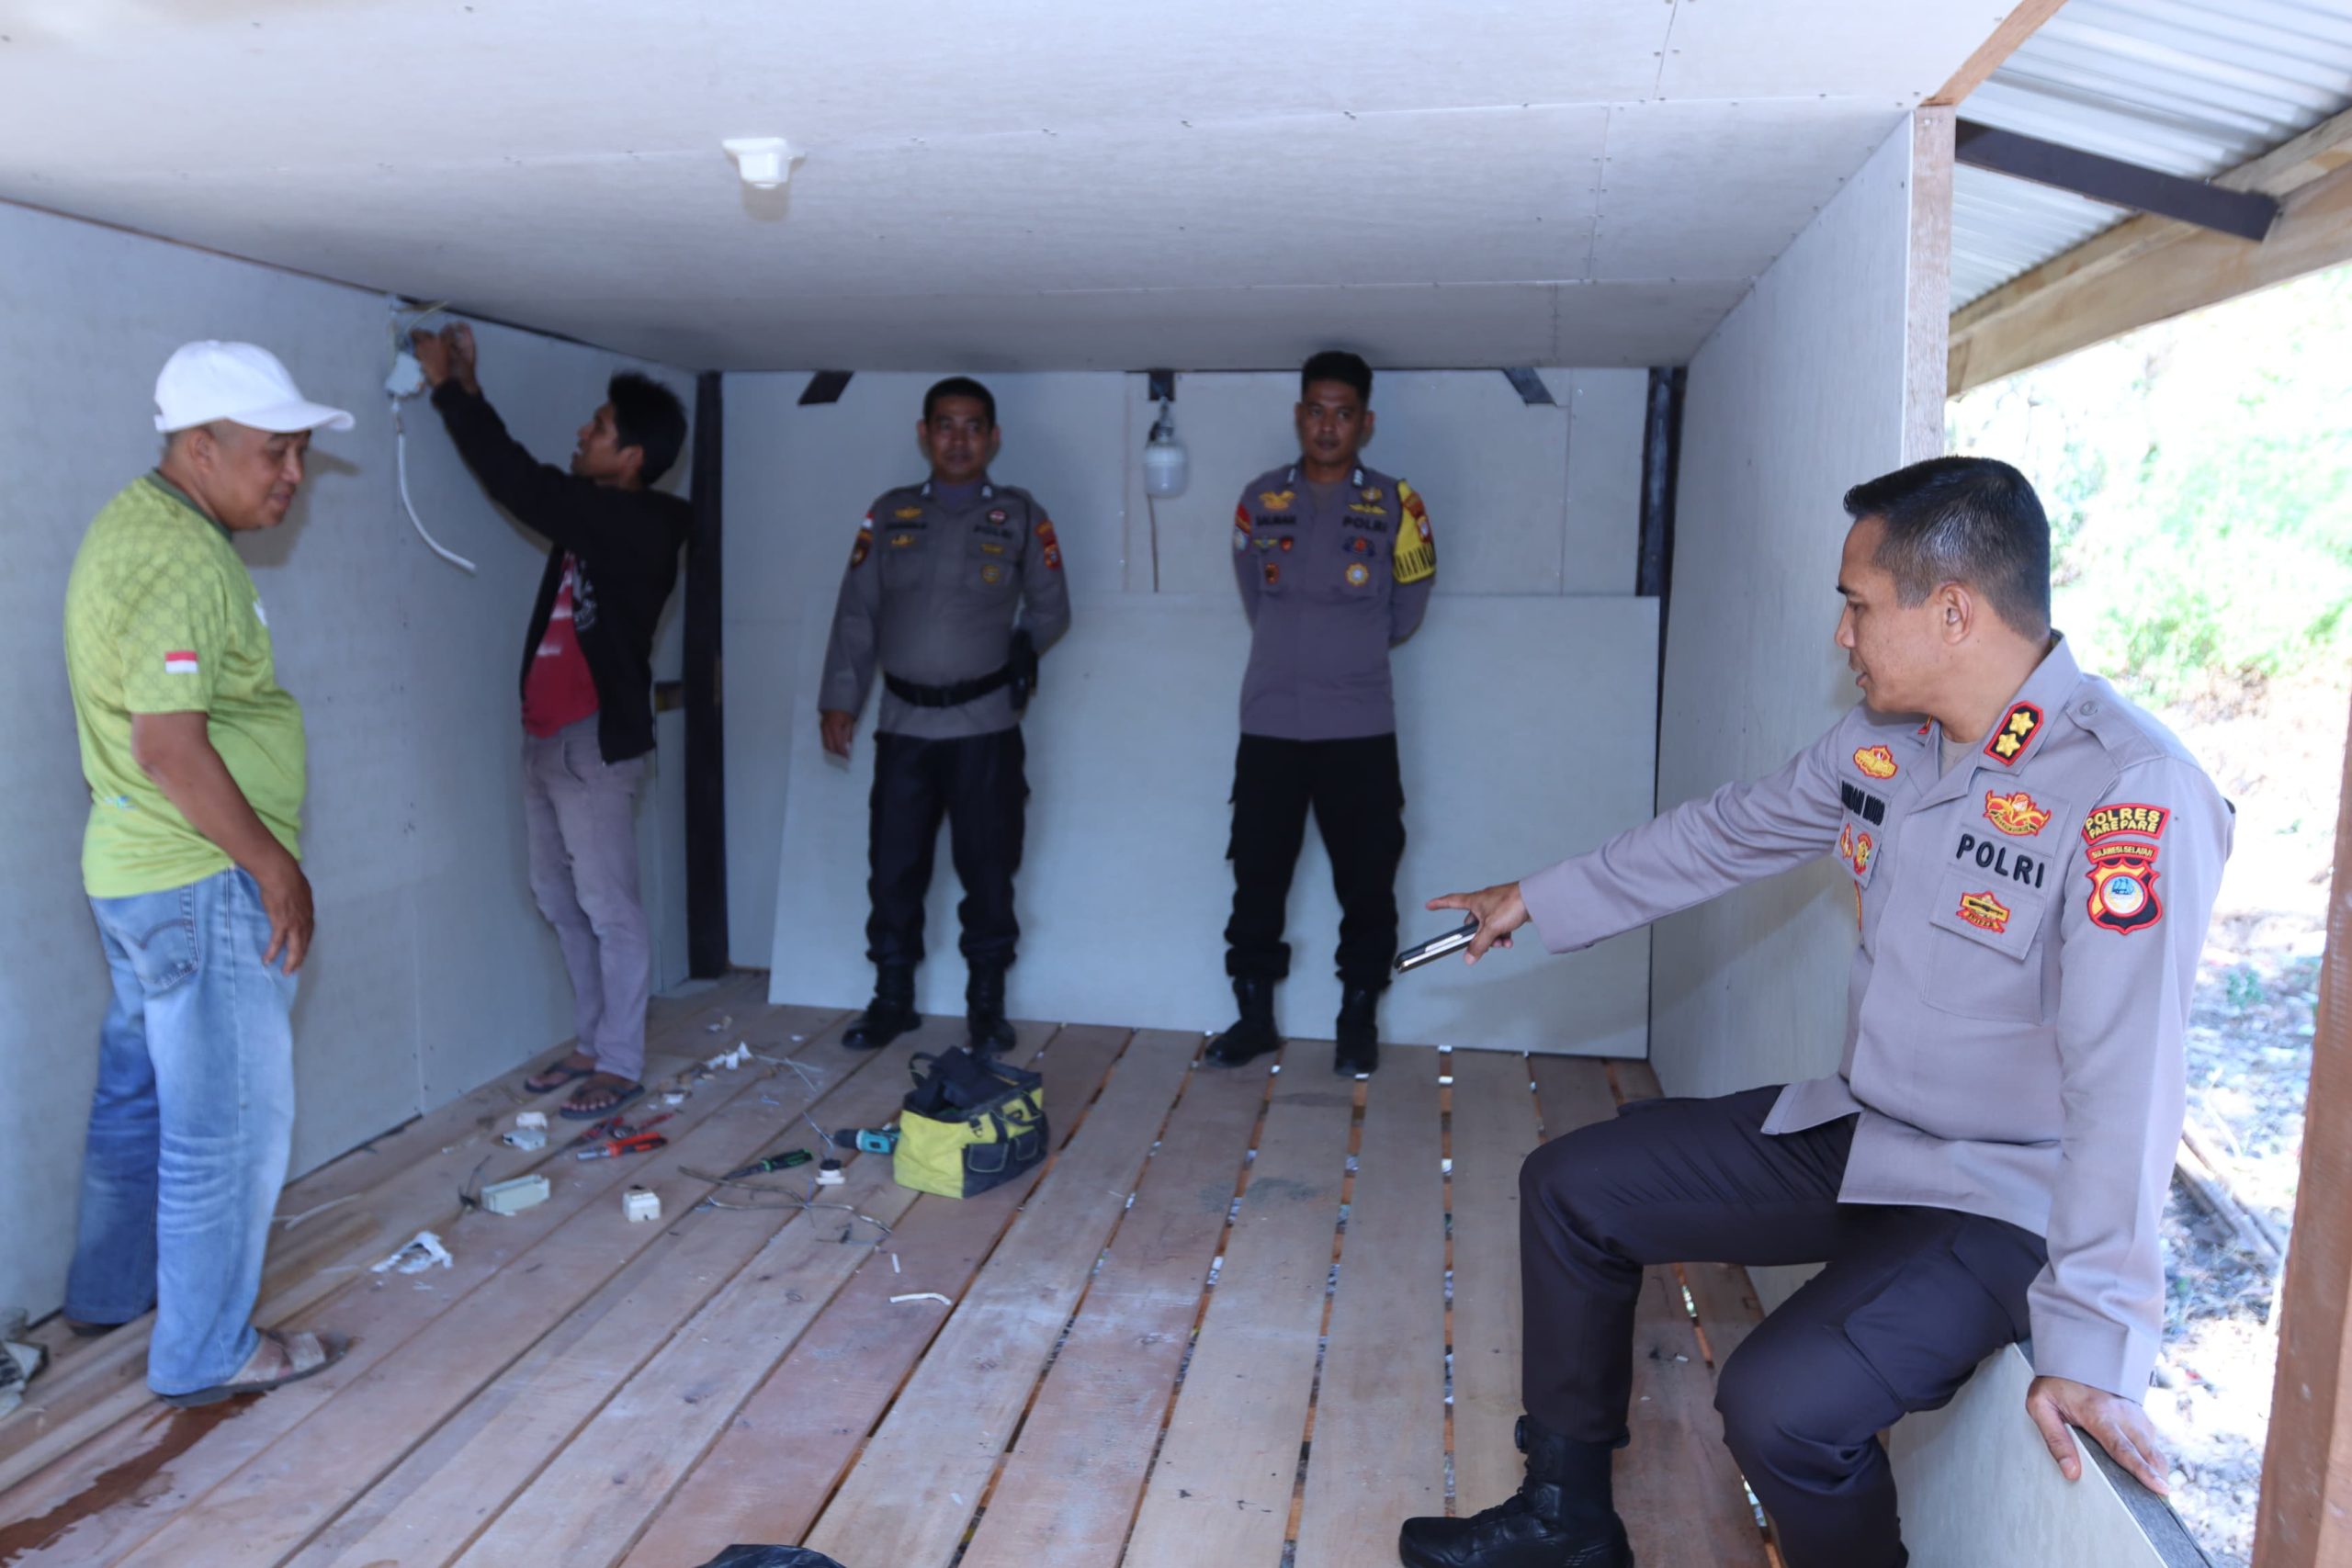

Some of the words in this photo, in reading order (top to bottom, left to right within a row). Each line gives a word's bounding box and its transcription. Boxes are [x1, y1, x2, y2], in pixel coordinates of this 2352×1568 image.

[1342, 515, 1387, 533] POLRI
[2086, 807, 2160, 830] POLRES
[2088, 819, 2158, 839] PAREPARE
[1956, 833, 2044, 888] POLRI
